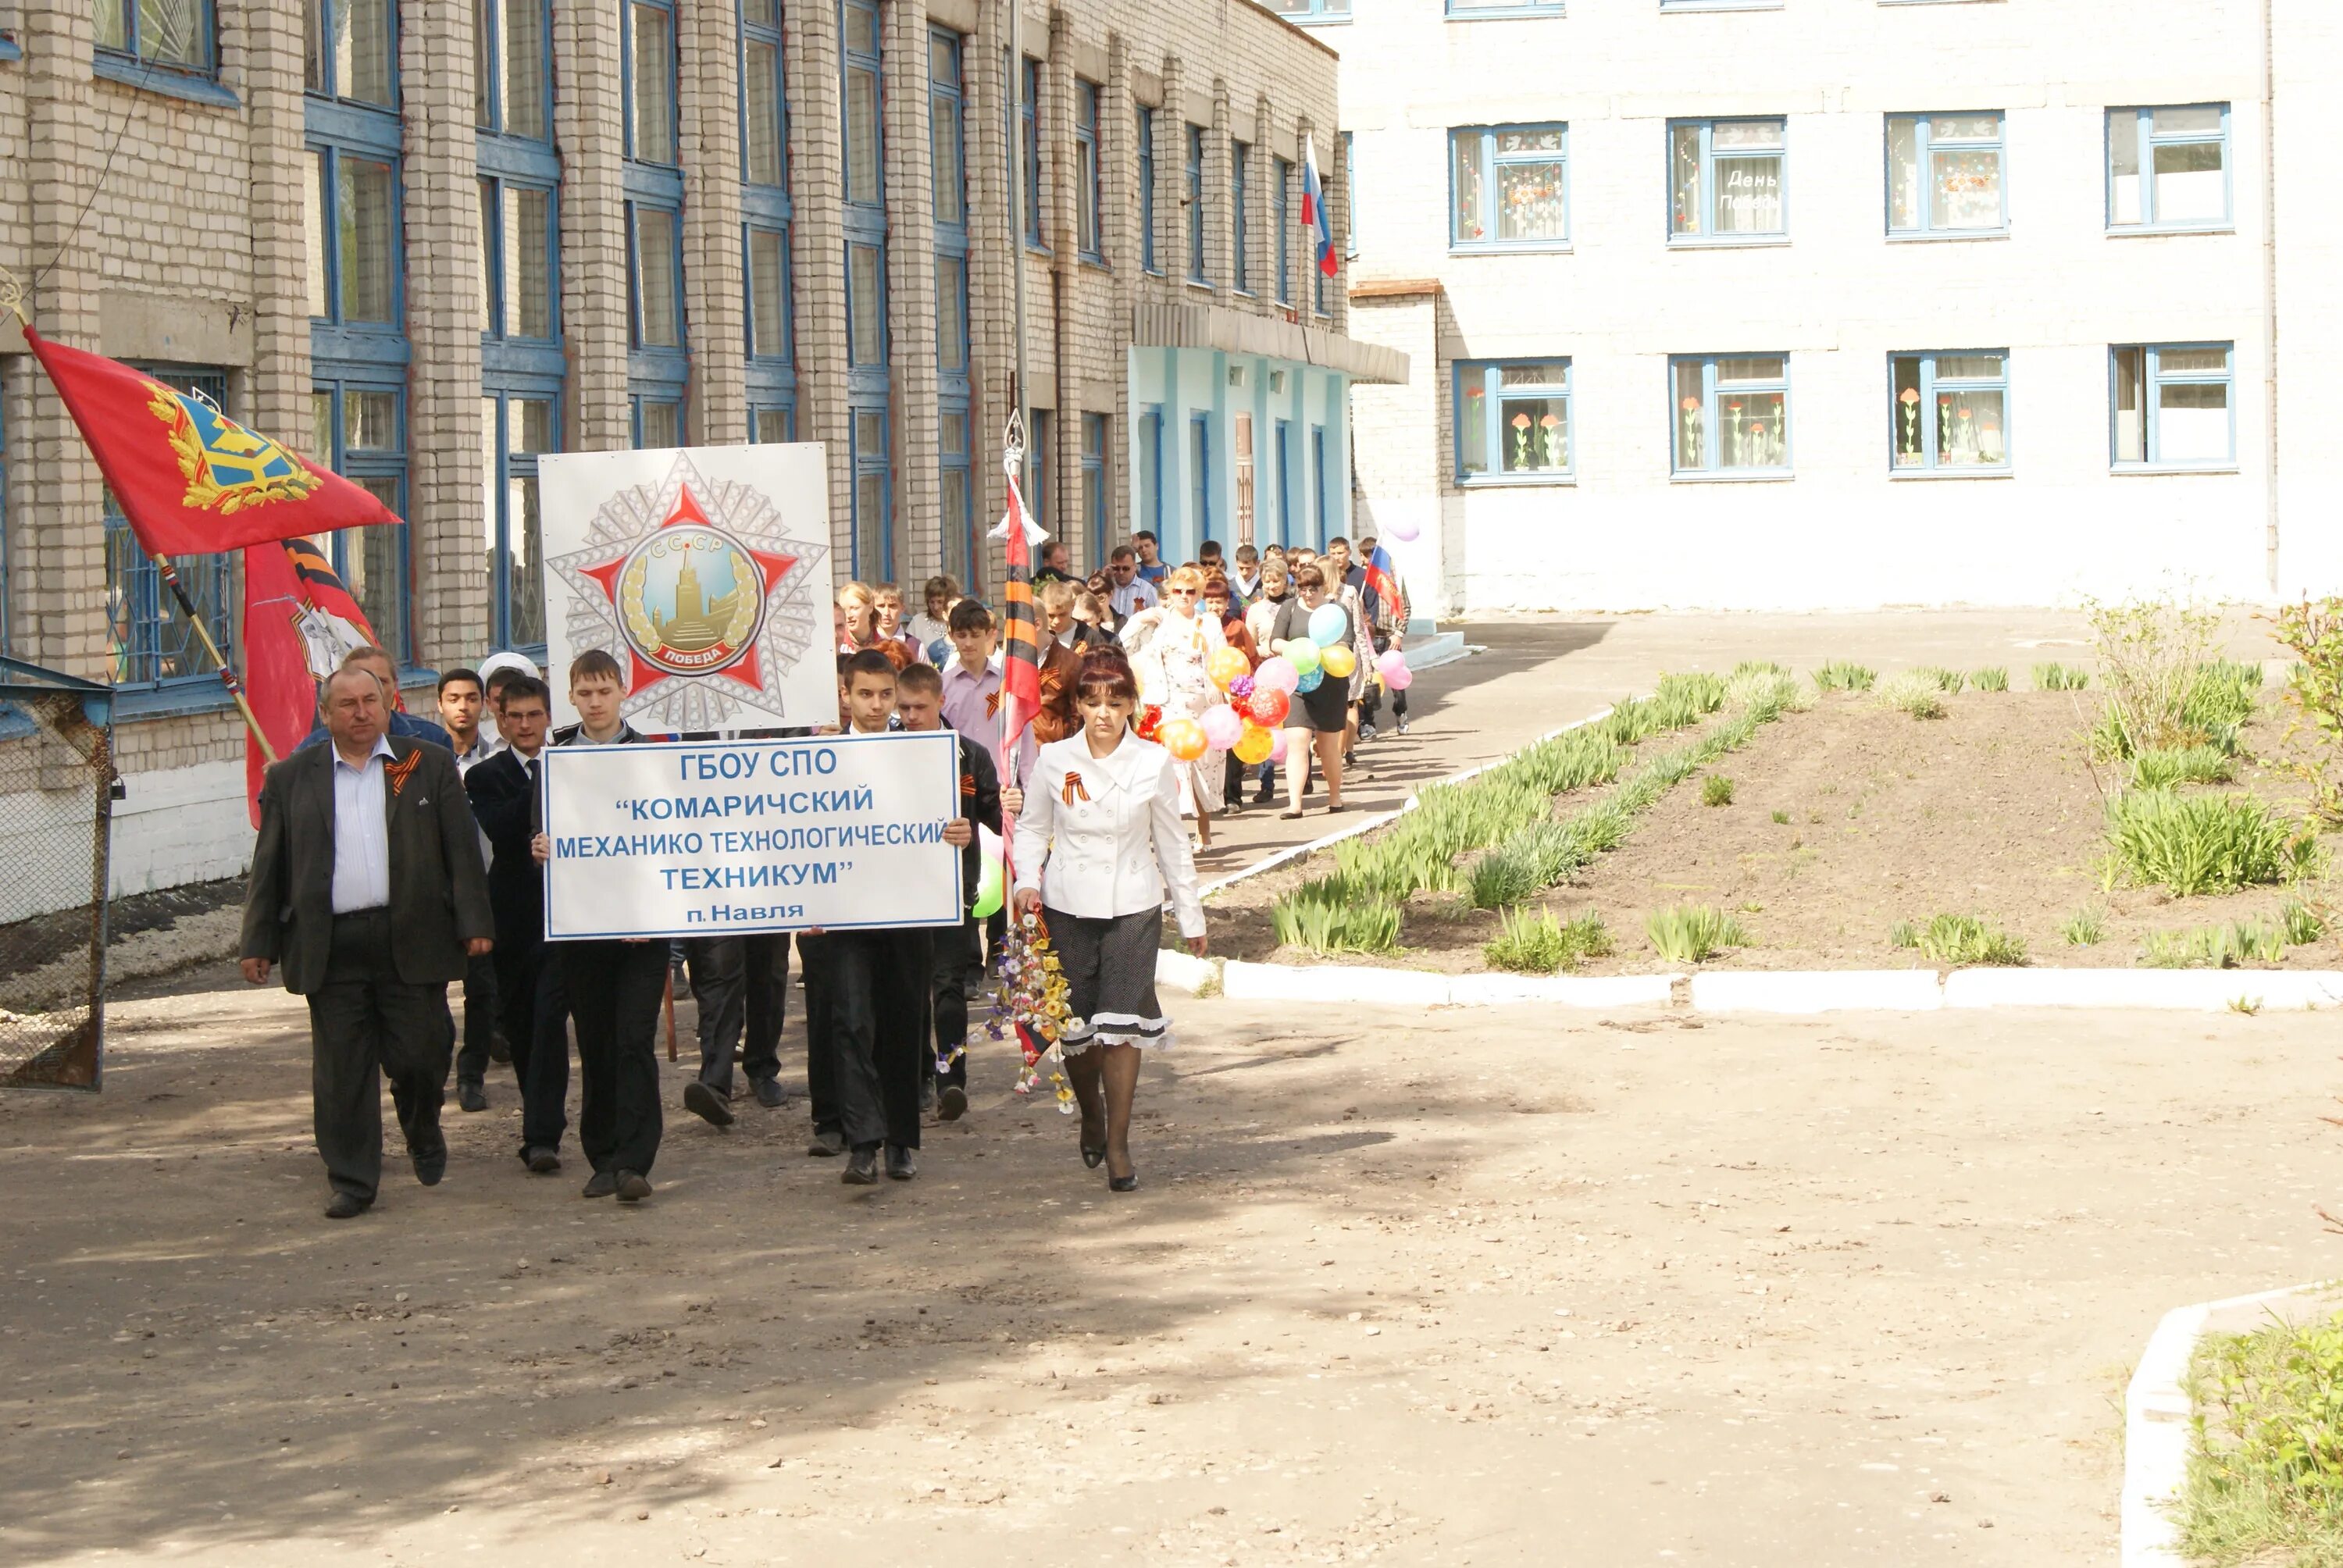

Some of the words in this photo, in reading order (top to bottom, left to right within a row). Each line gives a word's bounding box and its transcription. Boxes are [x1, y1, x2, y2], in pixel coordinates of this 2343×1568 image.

[1728, 169, 1777, 187] День
[651, 534, 723, 558] СССР
[665, 648, 722, 664] ПОБЕДА
[680, 752, 760, 780] ГБОУ
[770, 748, 837, 777] СПО
[556, 832, 703, 858] МЕХАНИКО
[710, 817, 948, 853] ТЕХНОЛОГИЧЕСКИЙ
[687, 910, 706, 923] п.
[711, 904, 804, 922] Навля
